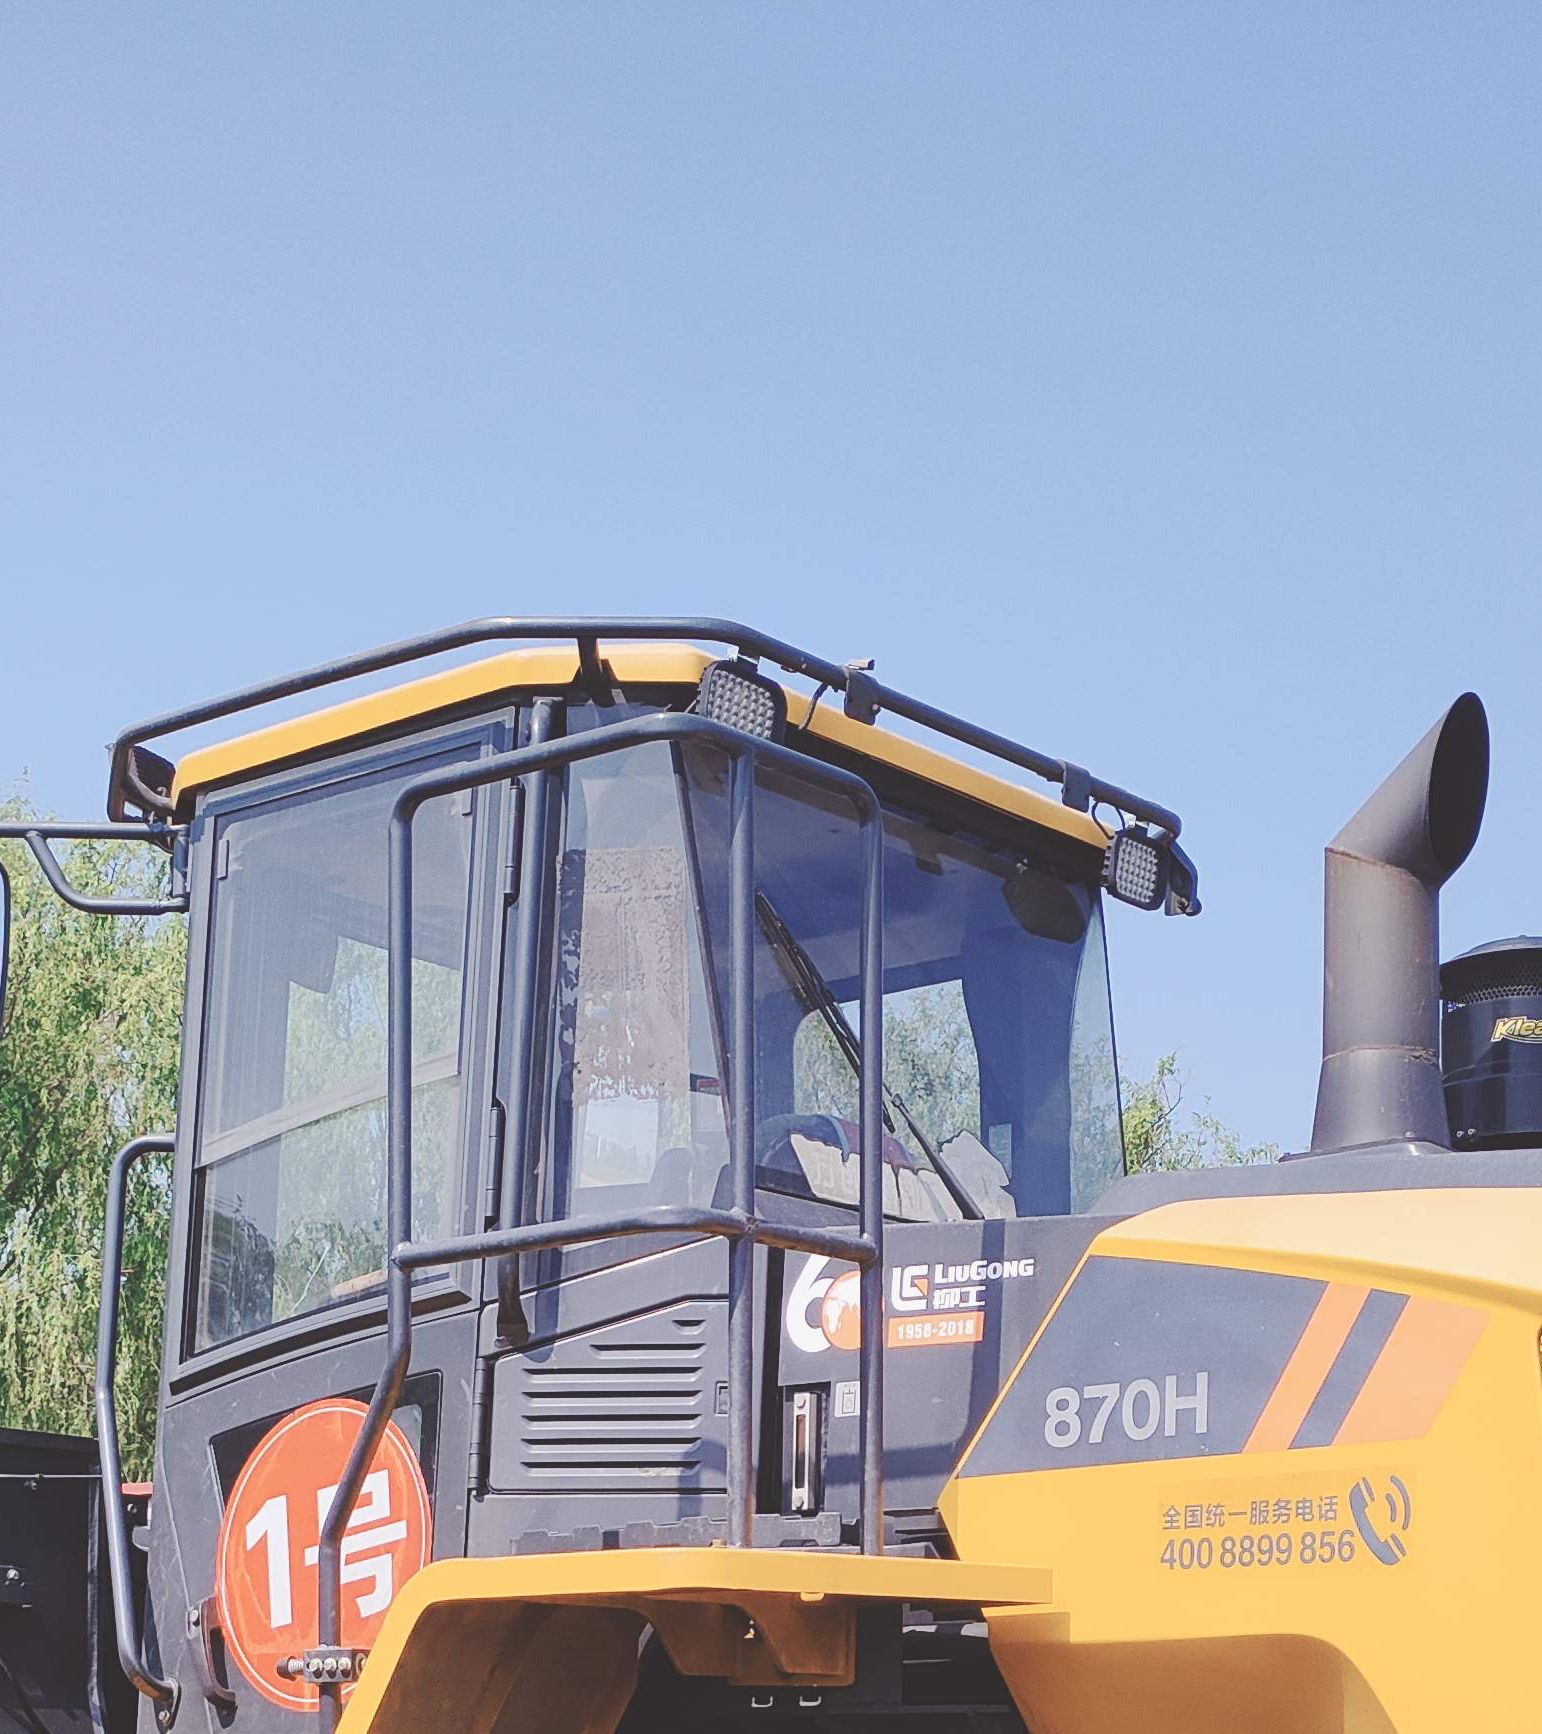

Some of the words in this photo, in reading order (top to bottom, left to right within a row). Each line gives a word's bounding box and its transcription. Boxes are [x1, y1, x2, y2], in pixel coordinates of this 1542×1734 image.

[932, 1285, 987, 1310] 柳工
[896, 1319, 975, 1340] 1958-2018
[1043, 1371, 1209, 1449] 870H
[1161, 1494, 1340, 1531] 全国统一服务电话
[1160, 1538, 1213, 1570] 400
[1219, 1533, 1293, 1569] 8899
[1299, 1529, 1357, 1565] 856
